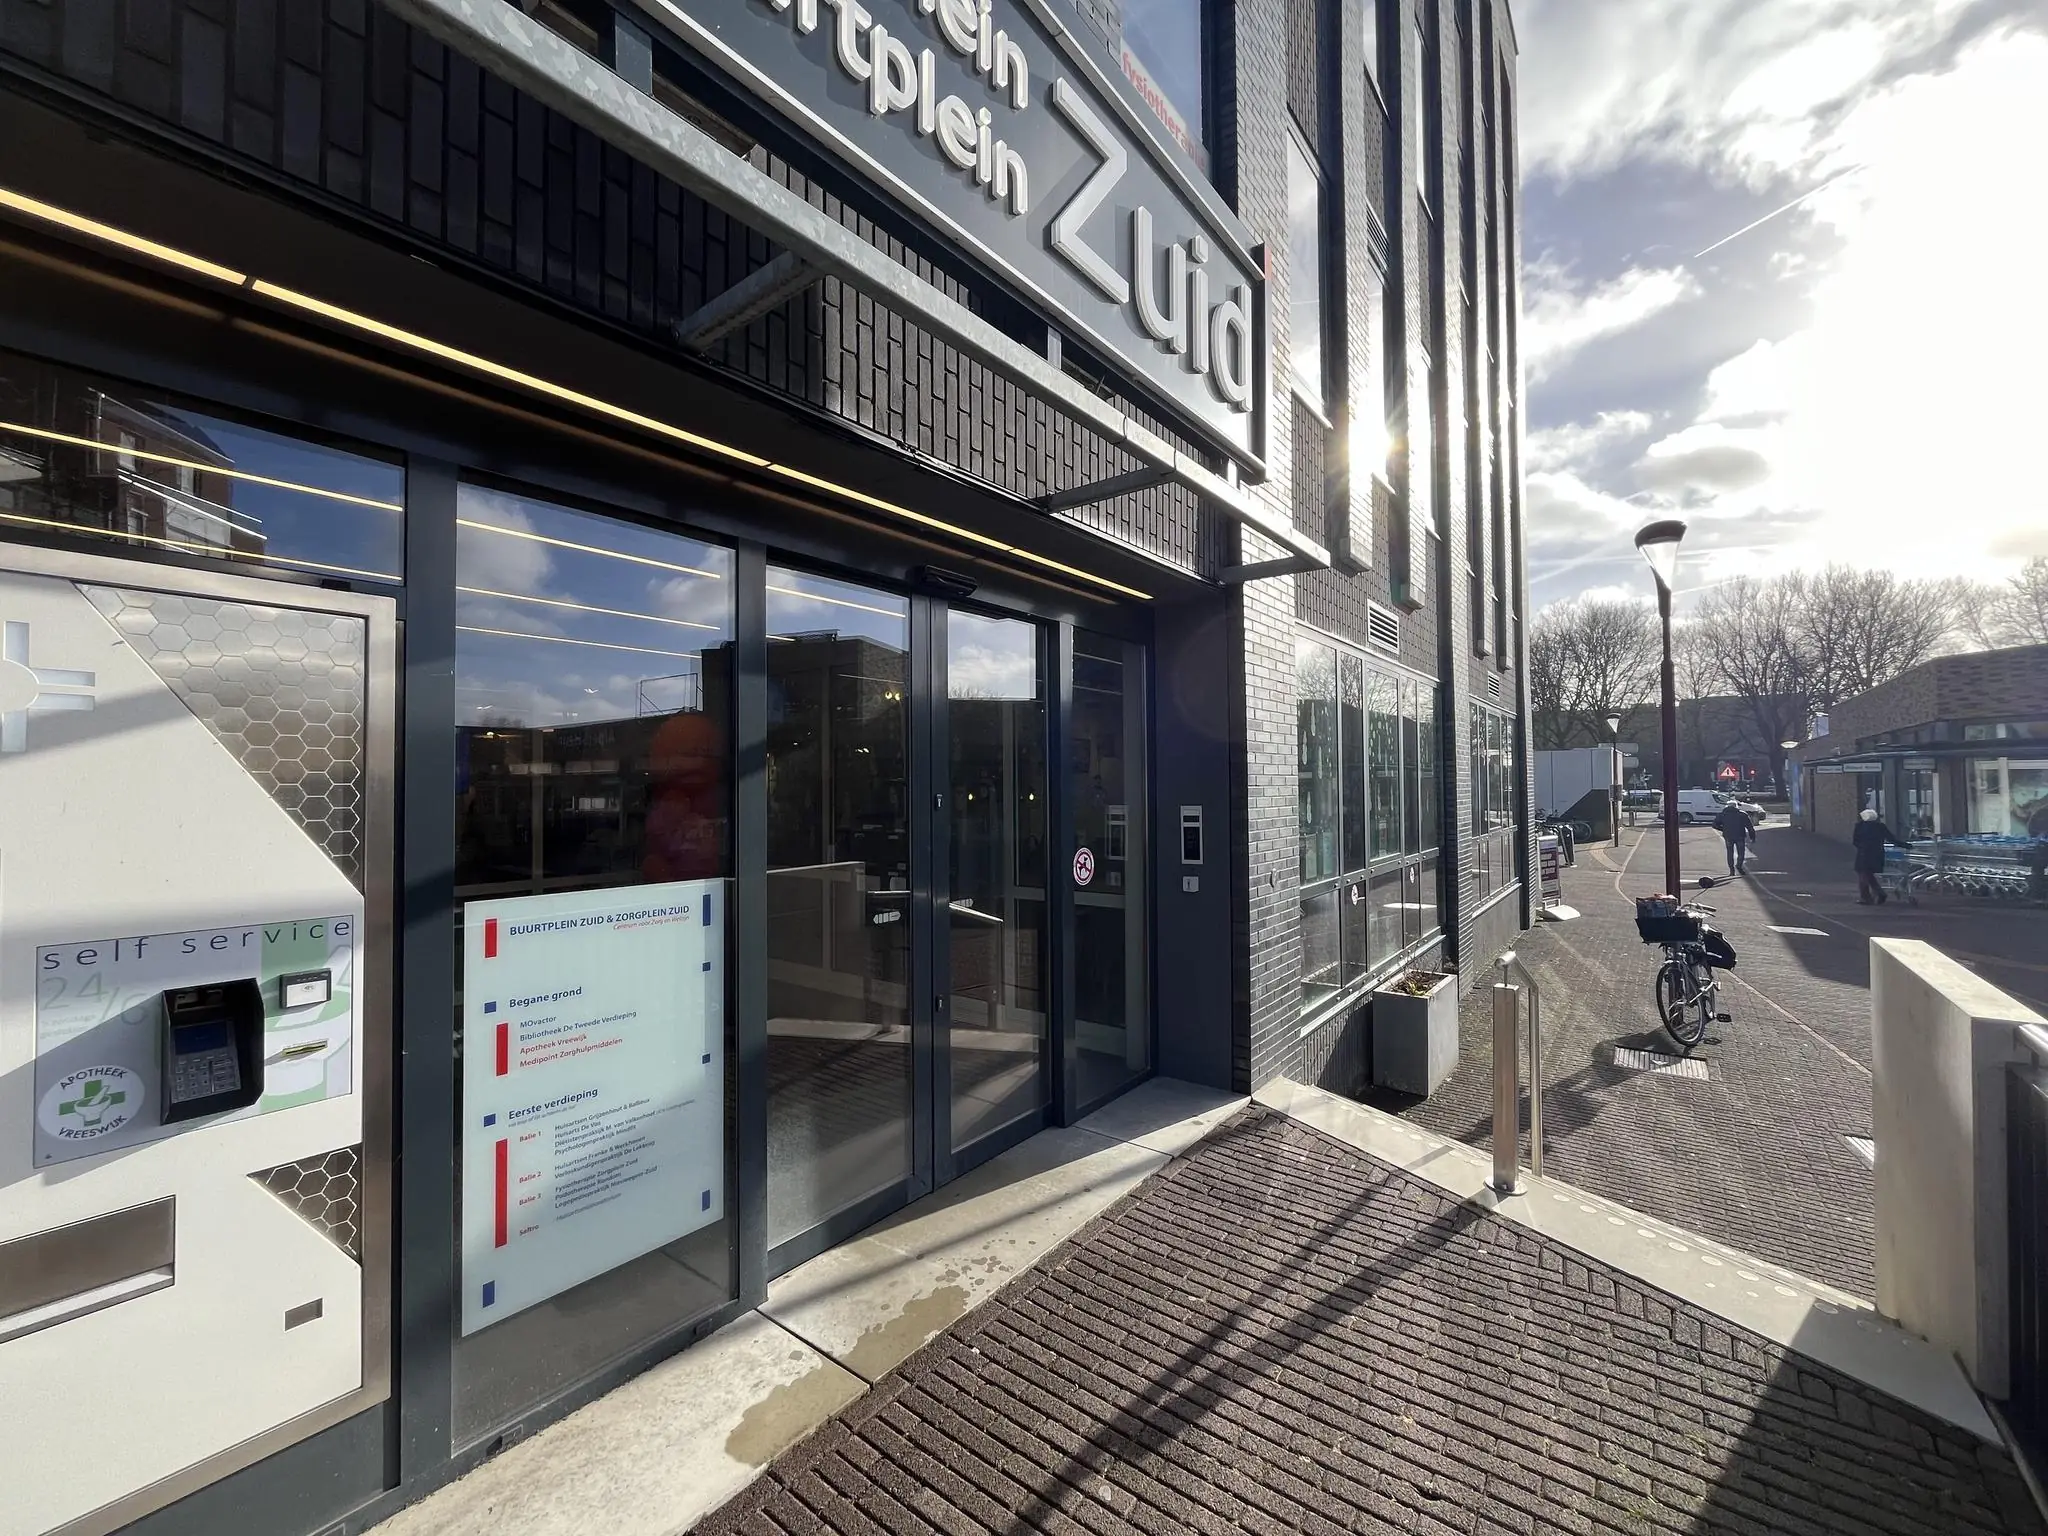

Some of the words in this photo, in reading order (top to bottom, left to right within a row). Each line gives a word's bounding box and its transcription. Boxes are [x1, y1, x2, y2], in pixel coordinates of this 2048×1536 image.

[919, 0, 1029, 109] ein
[1050, 77, 1252, 412] Zuid
[510, 919, 578, 935] BUURTPLEIN
[580, 916, 604, 927] ZUID
[606, 914, 614, 924] &
[616, 908, 667, 922] ZORGPLEIN
[669, 905, 690, 915] ZUID
[43, 936, 150, 970] self
[182, 920, 350, 955] service
[509, 992, 550, 1008] Begane
[551, 986, 583, 1002] grond
[519, 1027, 562, 1041] Bibliotheek
[563, 1024, 574, 1033] De
[575, 1018, 601, 1030] Tweede
[601, 1010, 637, 1024] Verdieping
[519, 1039, 556, 1055] Apotheek
[519, 1052, 558, 1067] Medipoint
[559, 1037, 623, 1058] Zorghulpmiddelen
[60, 1066, 128, 1090] APOTHEEK
[508, 1105, 542, 1120] Eerste
[544, 1088, 598, 1109] verdieping
[58, 1114, 128, 1140] VREESWIJK
